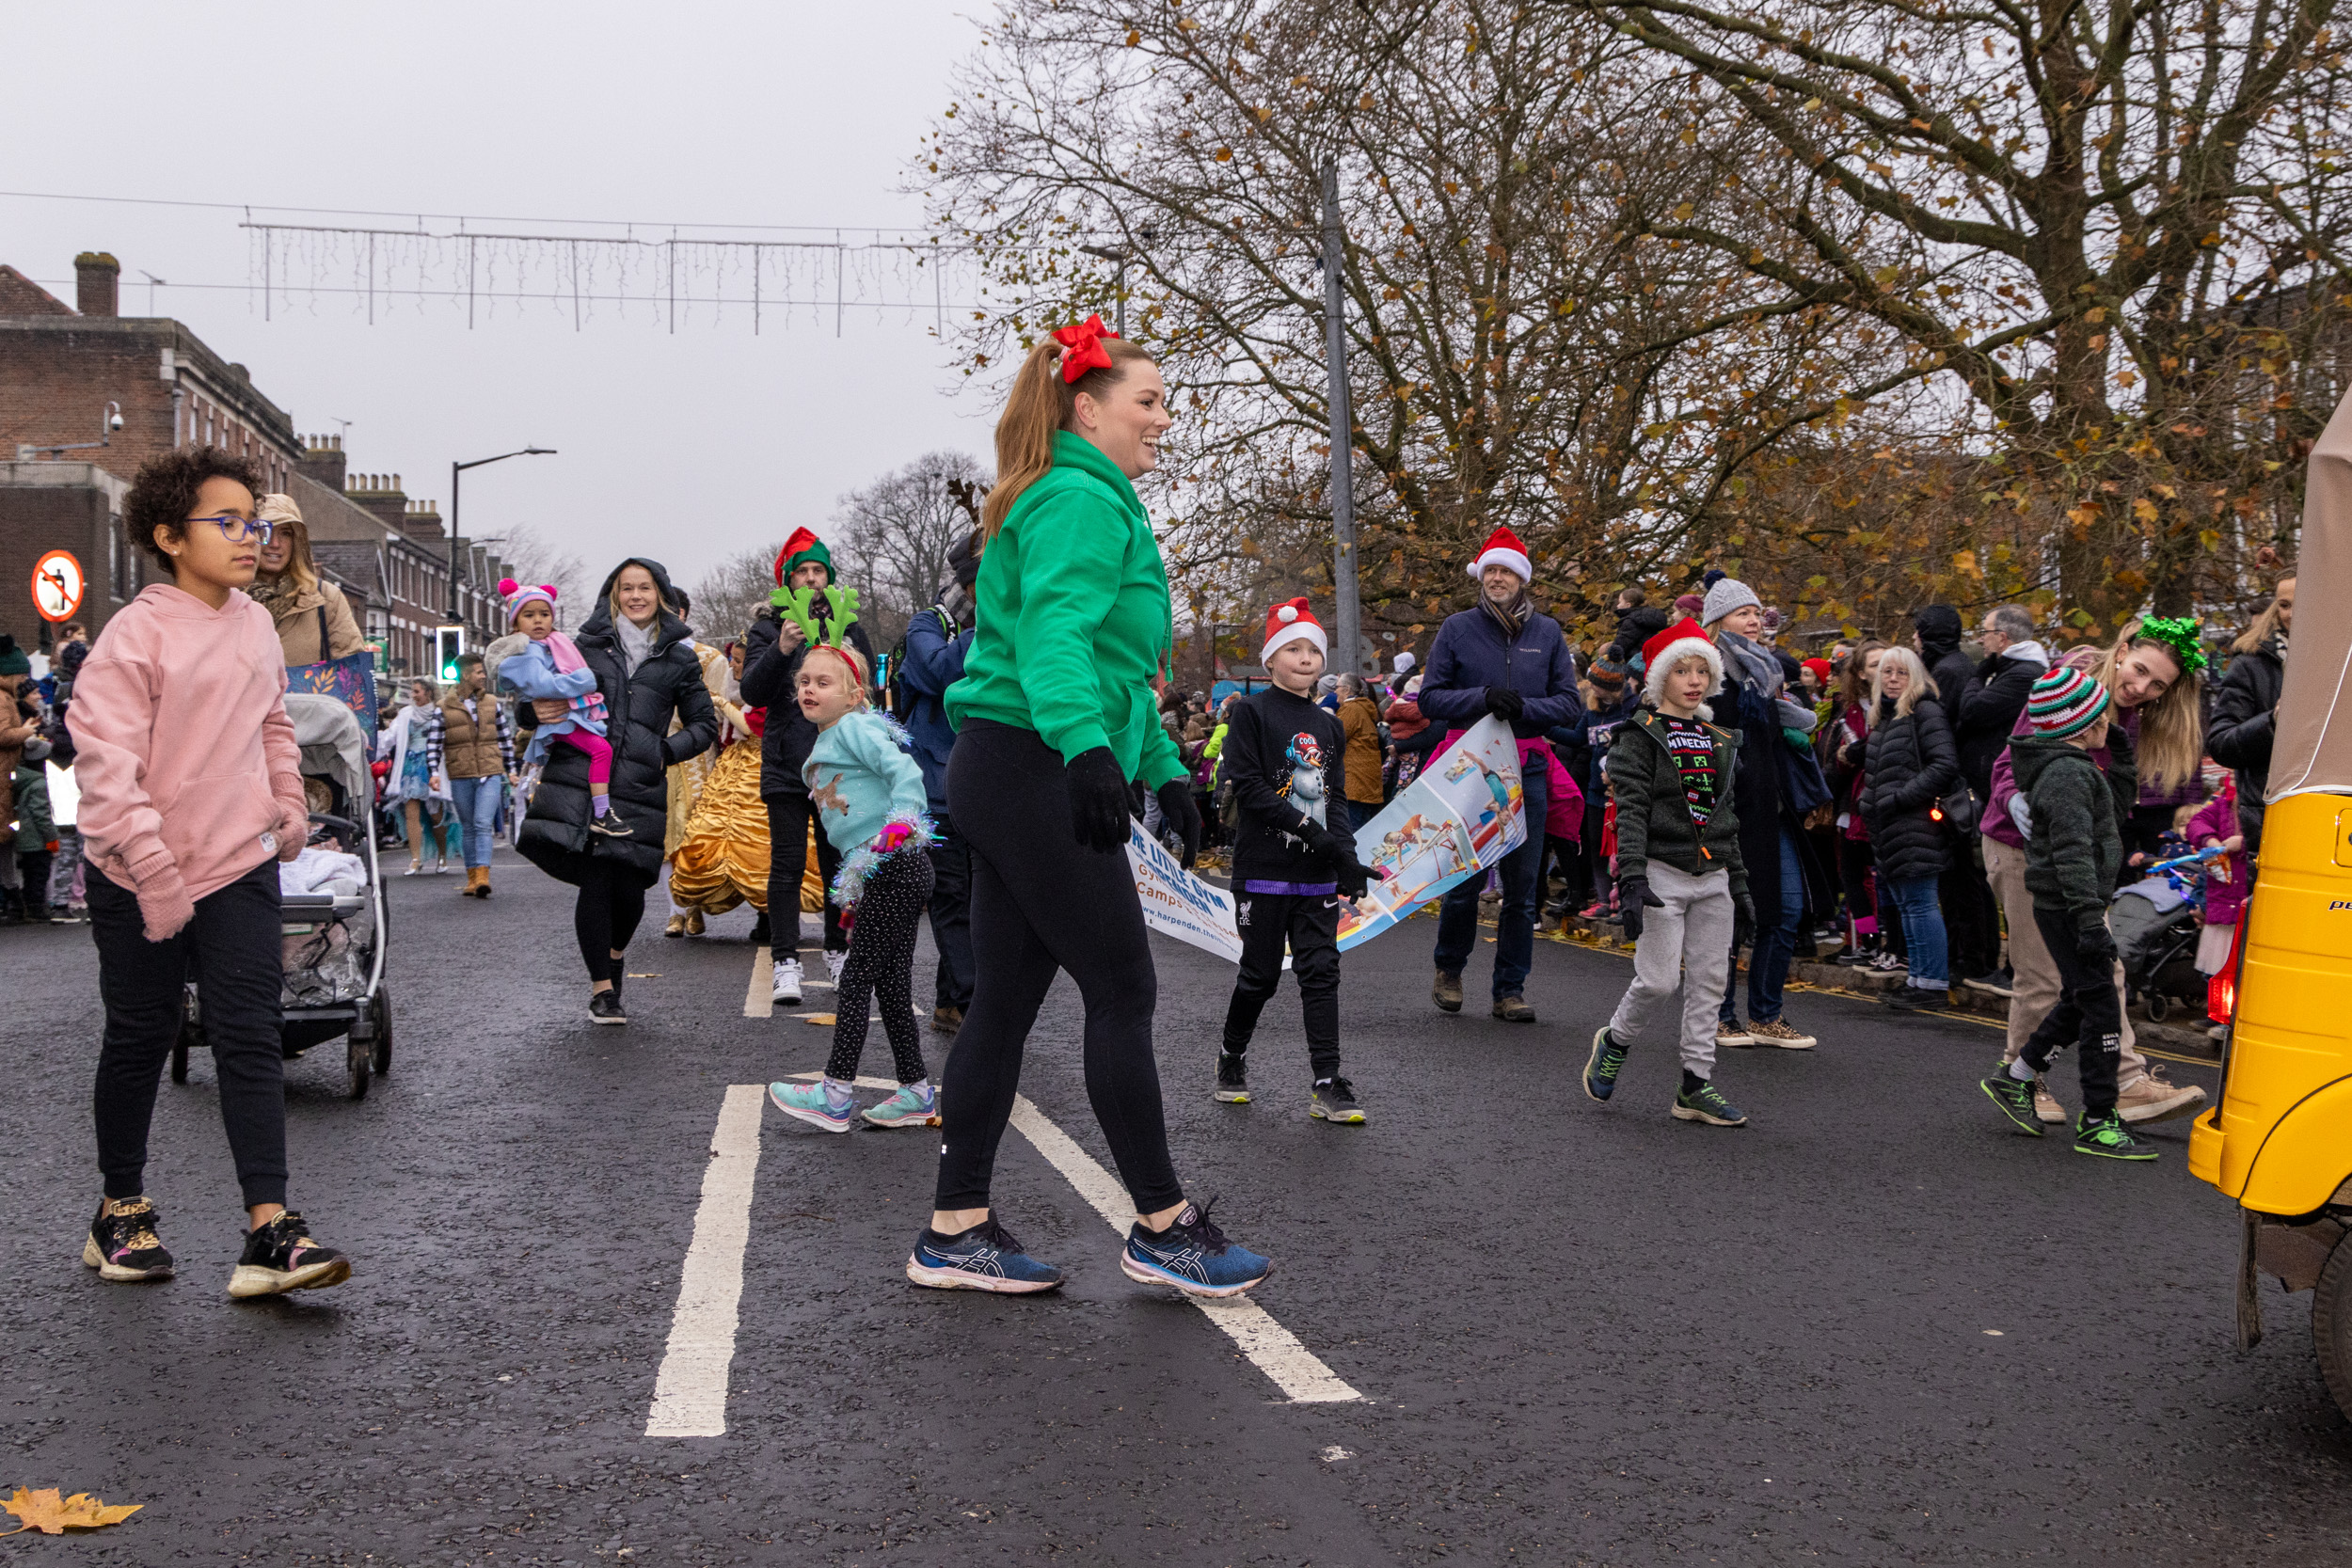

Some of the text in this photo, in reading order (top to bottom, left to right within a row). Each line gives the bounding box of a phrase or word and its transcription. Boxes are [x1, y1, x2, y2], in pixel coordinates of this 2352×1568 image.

[1132, 826, 1147, 856] HE
[1150, 843, 1190, 890] LITTLE
[1190, 879, 1230, 911] GYM
[1136, 881, 1183, 909] Camps
